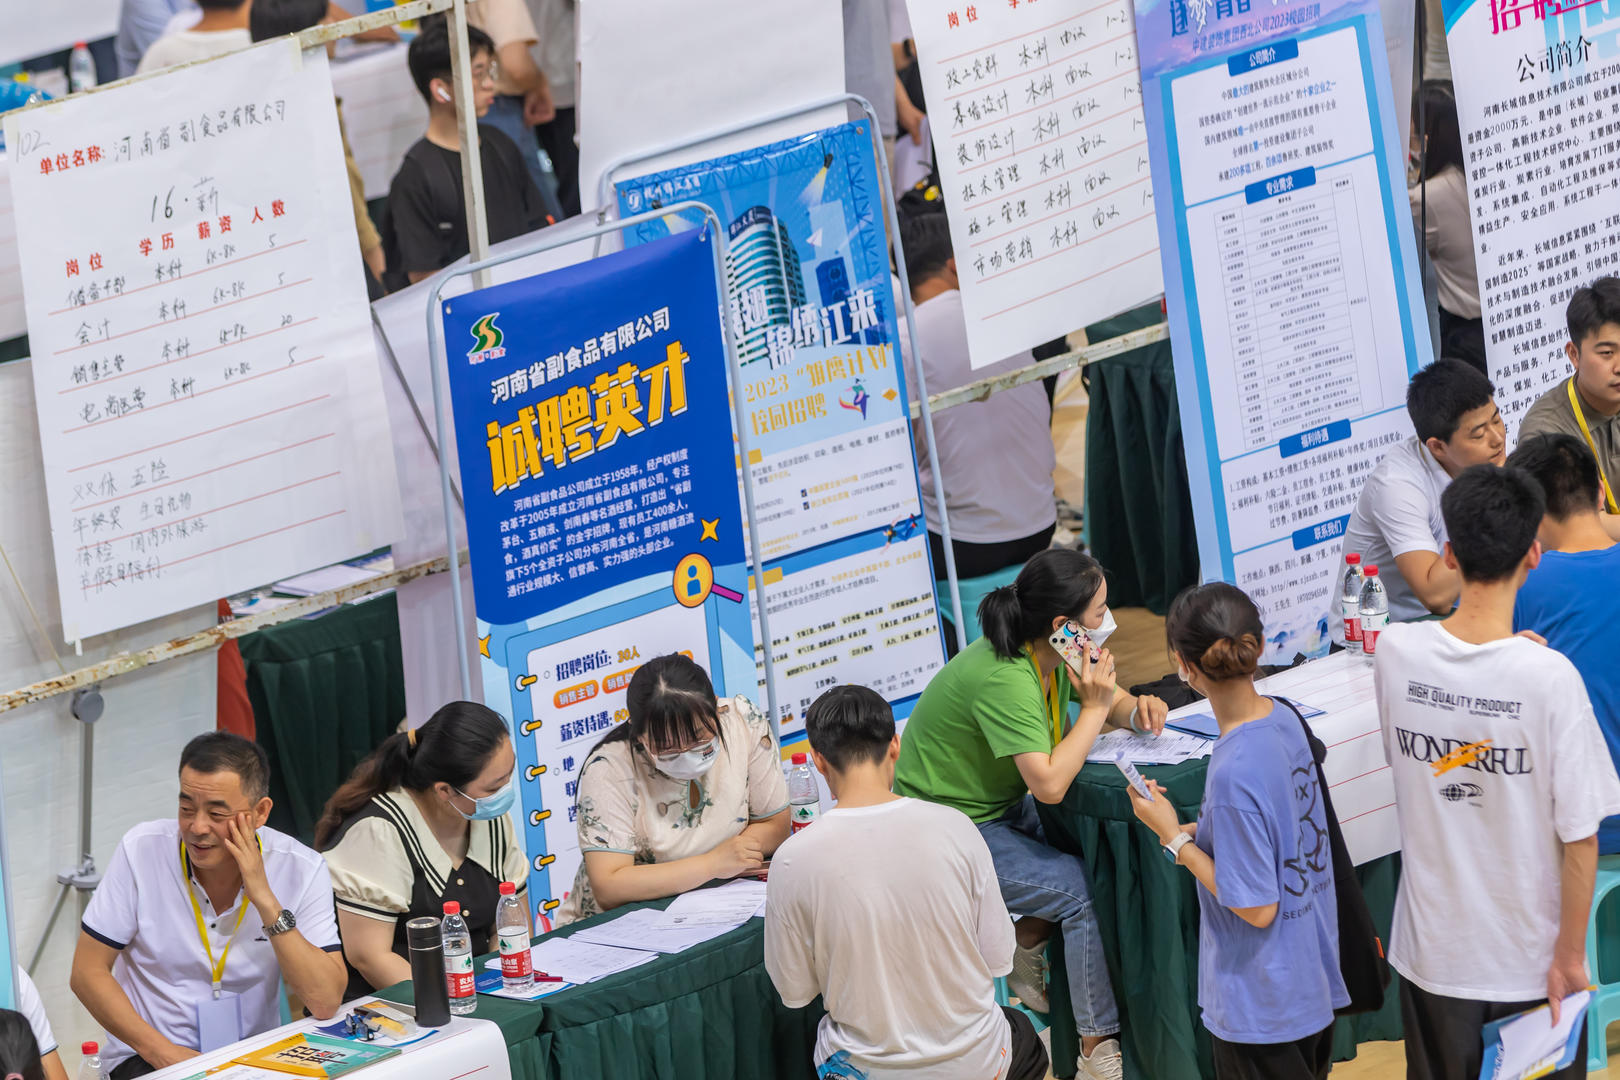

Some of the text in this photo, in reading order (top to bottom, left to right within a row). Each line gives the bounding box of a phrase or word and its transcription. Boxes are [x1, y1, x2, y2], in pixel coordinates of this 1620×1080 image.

[948, 6, 979, 29] 岗位
[1018, 37, 1050, 66] 本科
[1249, 47, 1277, 67] 公司简介
[1517, 35, 1592, 83] 公司简介
[1025, 73, 1055, 105] 本科
[1032, 112, 1061, 142] 本科
[1040, 148, 1066, 175] 本科
[1044, 181, 1072, 210] 本科
[1265, 176, 1295, 196] 专业需求
[66, 199, 286, 278] 岗位 学历 薪资 人数
[1051, 221, 1079, 248] 本科
[154, 259, 183, 283] 本科
[75, 321, 111, 346] 会计
[158, 301, 187, 321] 本科
[162, 338, 191, 363] 本科
[491, 306, 670, 404] 河南省副食品有限公司
[169, 378, 196, 400] 本科
[486, 340, 691, 497] 诚聘英才
[751, 392, 828, 437] 校园招聘
[1313, 520, 1342, 541] 联系我们
[617, 646, 641, 664] 30人
[558, 682, 596, 705] 销售主管
[1408, 684, 1429, 700] HIGH
[1431, 690, 1474, 709] QUALITY
[1475, 698, 1523, 715] PRODUCT
[1395, 726, 1534, 776] WONDERFUL
